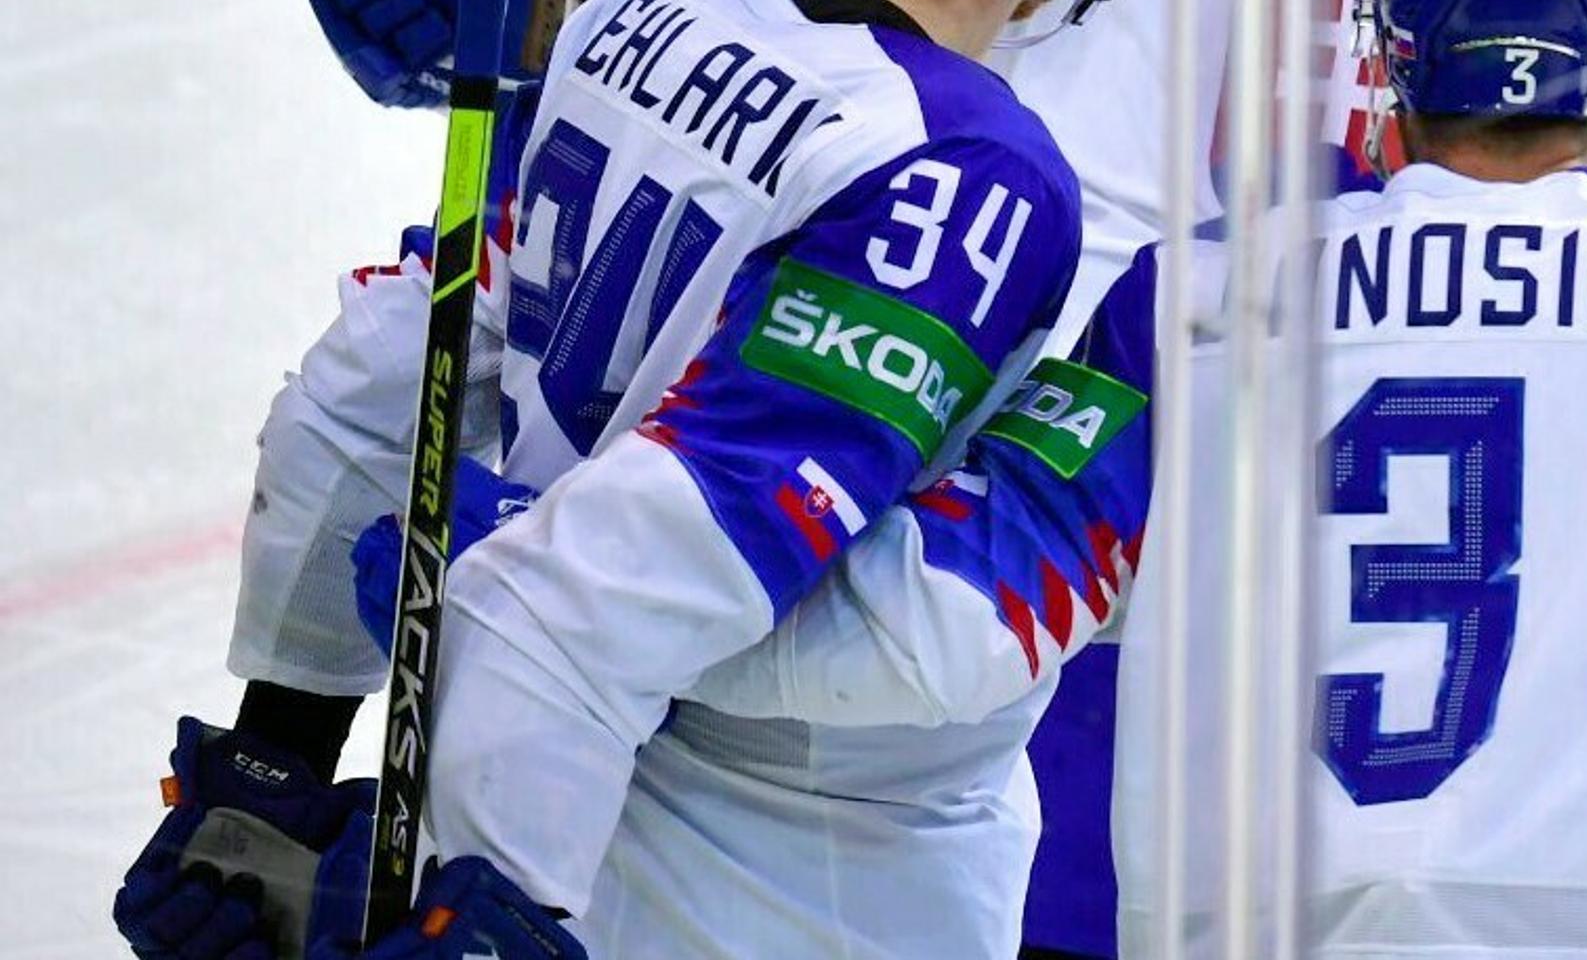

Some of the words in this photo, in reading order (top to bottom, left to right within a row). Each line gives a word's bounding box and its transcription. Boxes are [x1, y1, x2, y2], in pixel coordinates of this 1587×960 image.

[1501, 47, 1539, 104] 3
[865, 158, 1033, 328] 34
[420, 346, 452, 517] SUPER
[388, 522, 446, 781] TACKS
[1313, 377, 1526, 806] 3
